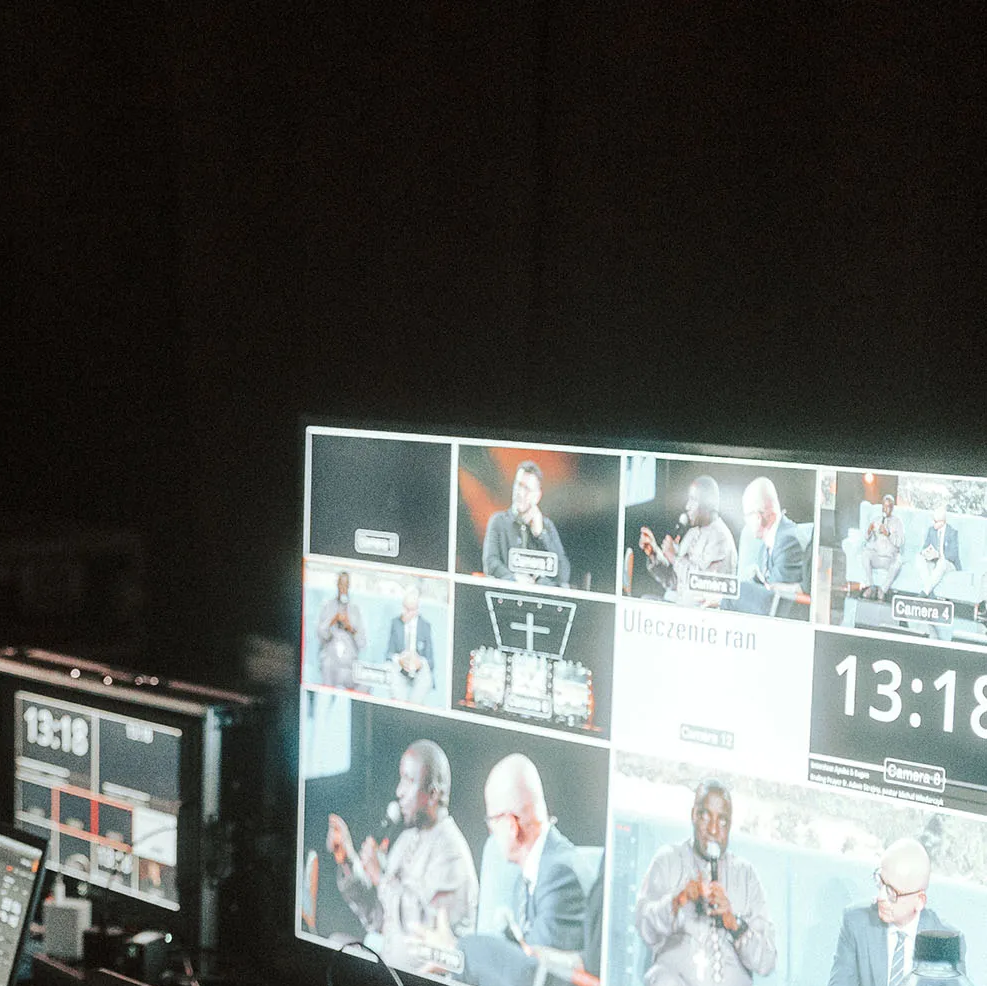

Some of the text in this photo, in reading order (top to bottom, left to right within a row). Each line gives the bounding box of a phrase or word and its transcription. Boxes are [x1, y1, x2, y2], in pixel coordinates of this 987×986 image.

[690, 574, 737, 595] Camera 3
[895, 601, 950, 620] Camera 4
[623, 608, 757, 651] Uleczenie ran
[887, 764, 931, 785] Camera
